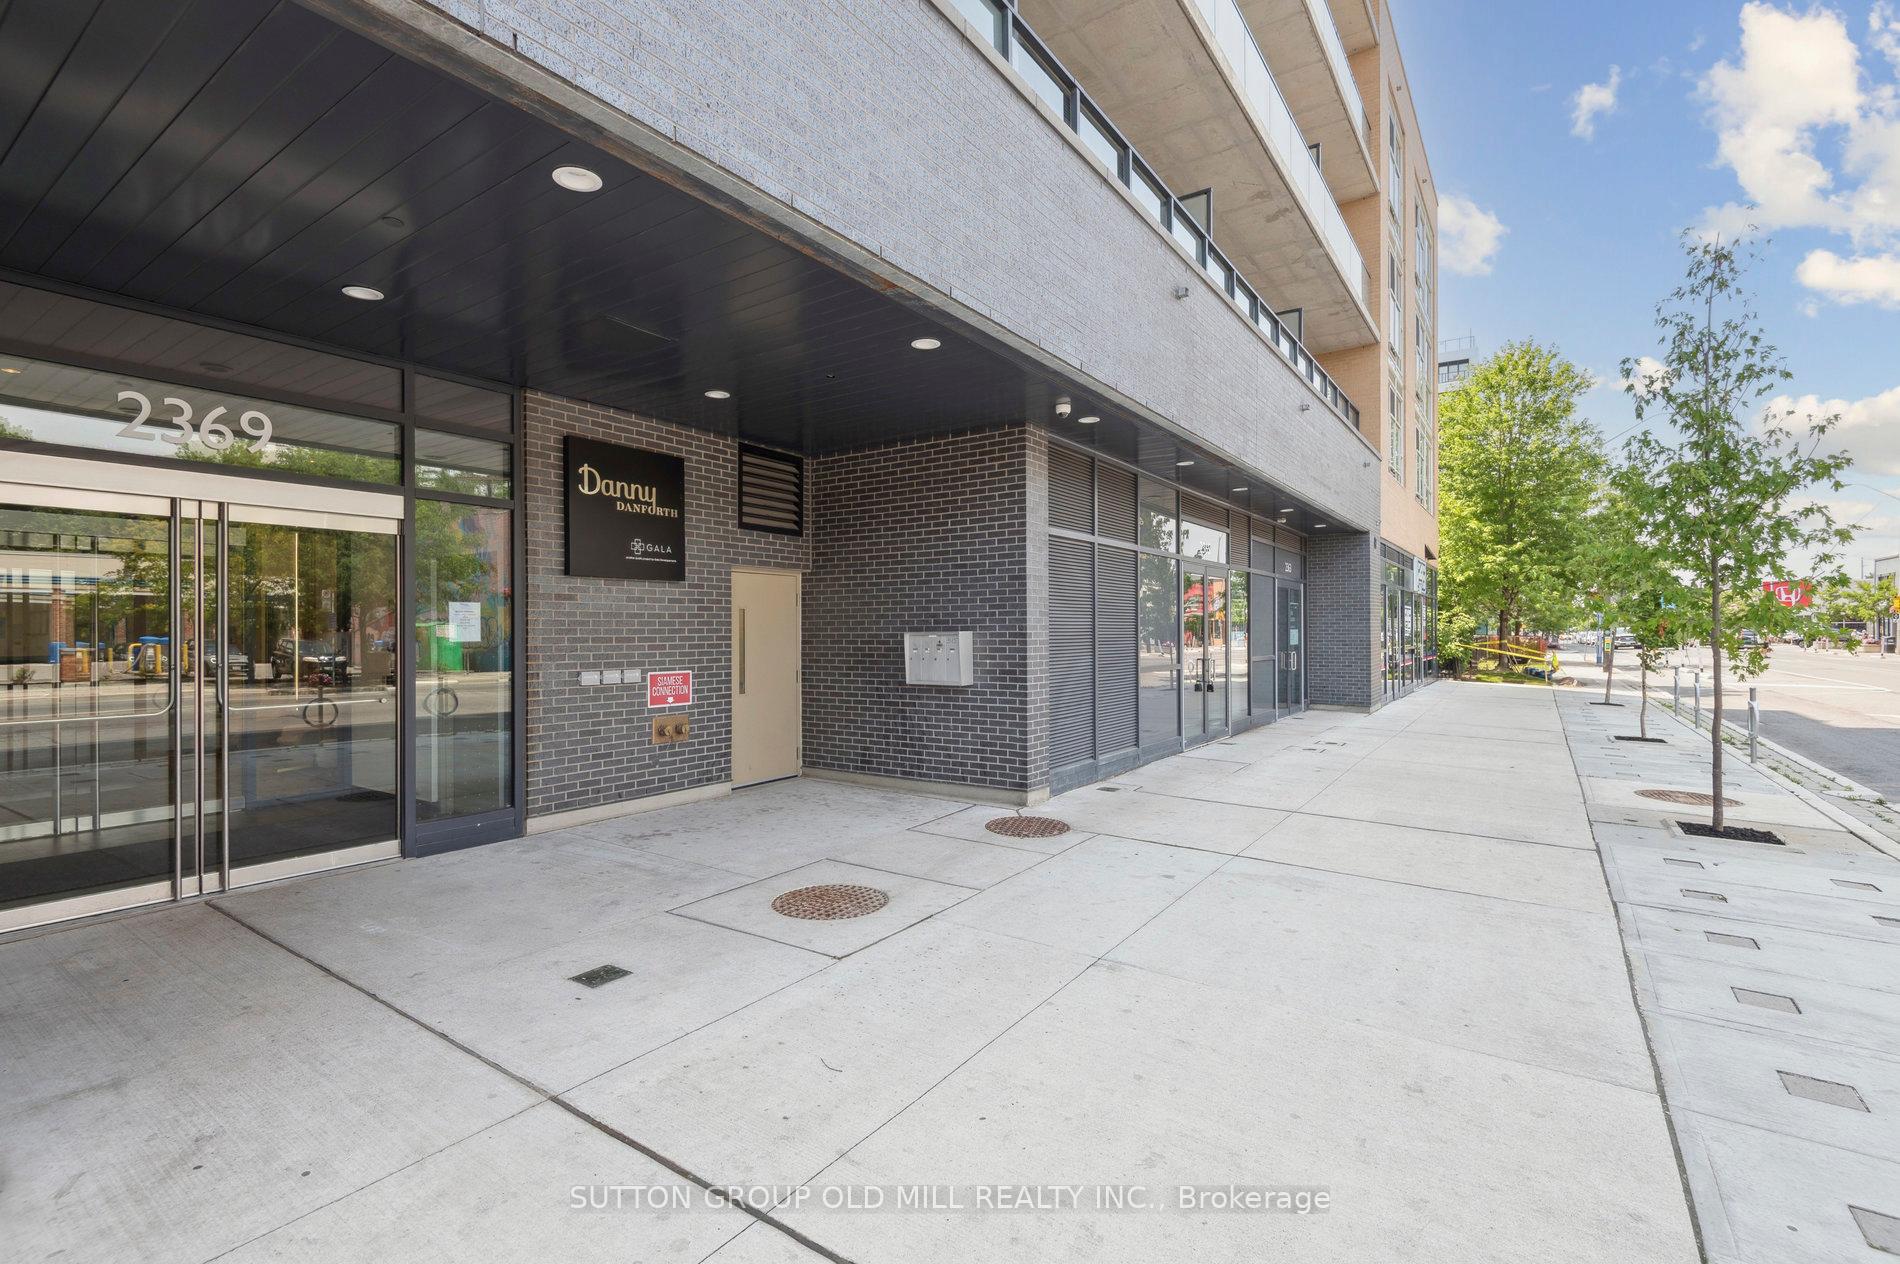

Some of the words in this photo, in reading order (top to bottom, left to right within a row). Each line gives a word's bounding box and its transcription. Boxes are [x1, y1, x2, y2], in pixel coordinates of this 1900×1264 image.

[115, 390, 273, 453] 2369
[578, 463, 657, 513] Danny
[616, 501, 678, 518] DANFORTH
[646, 544, 672, 553] GALA
[657, 675, 684, 686] SIAMESE
[652, 685, 689, 696] CONNECTION
